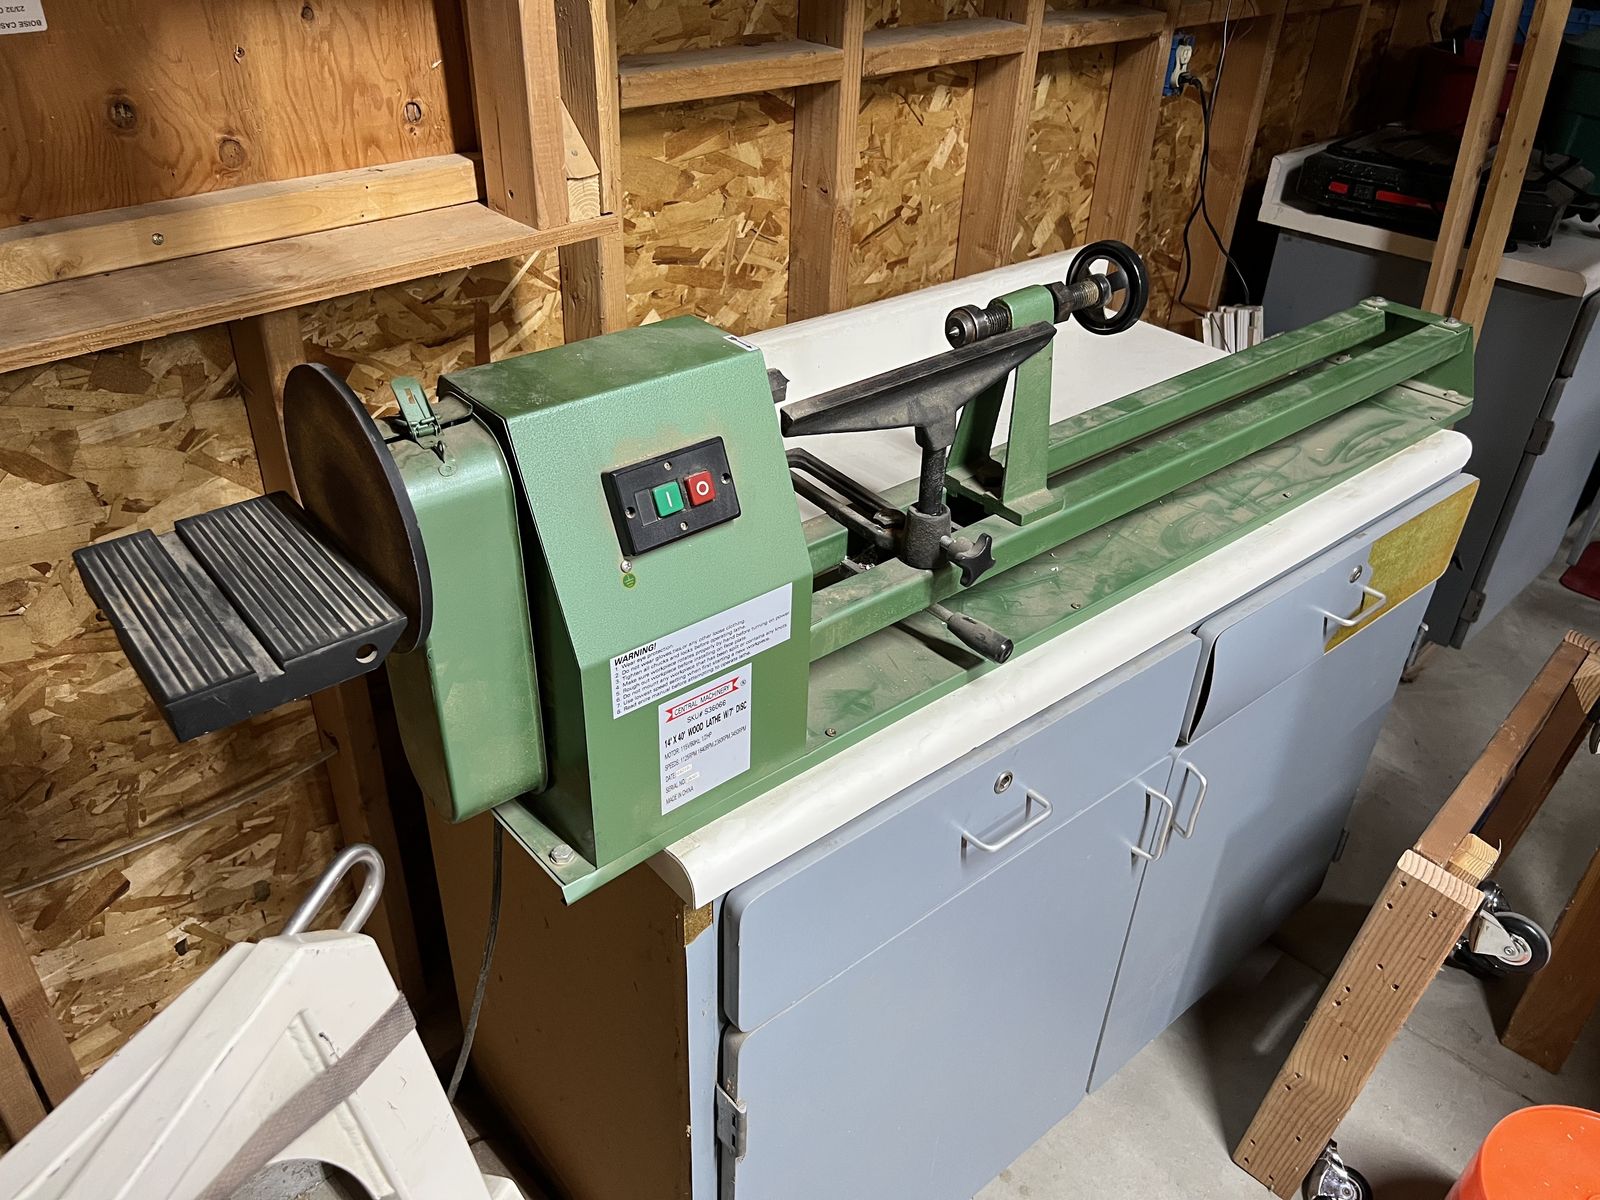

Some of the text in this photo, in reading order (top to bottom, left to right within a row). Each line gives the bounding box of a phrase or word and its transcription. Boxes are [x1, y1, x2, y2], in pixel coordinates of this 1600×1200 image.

[18, 20, 42, 28] BOISE
[614, 642, 657, 666] WARNING!
[674, 685, 730, 716] CENTRAL MACHINERY
[687, 700, 726, 723] SKU# S36066
[673, 735, 677, 744] X
[688, 722, 704, 737] WOOD
[706, 713, 721, 728] LATHE
[736, 700, 747, 713] DISC
[682, 786, 694, 796] CHINA
